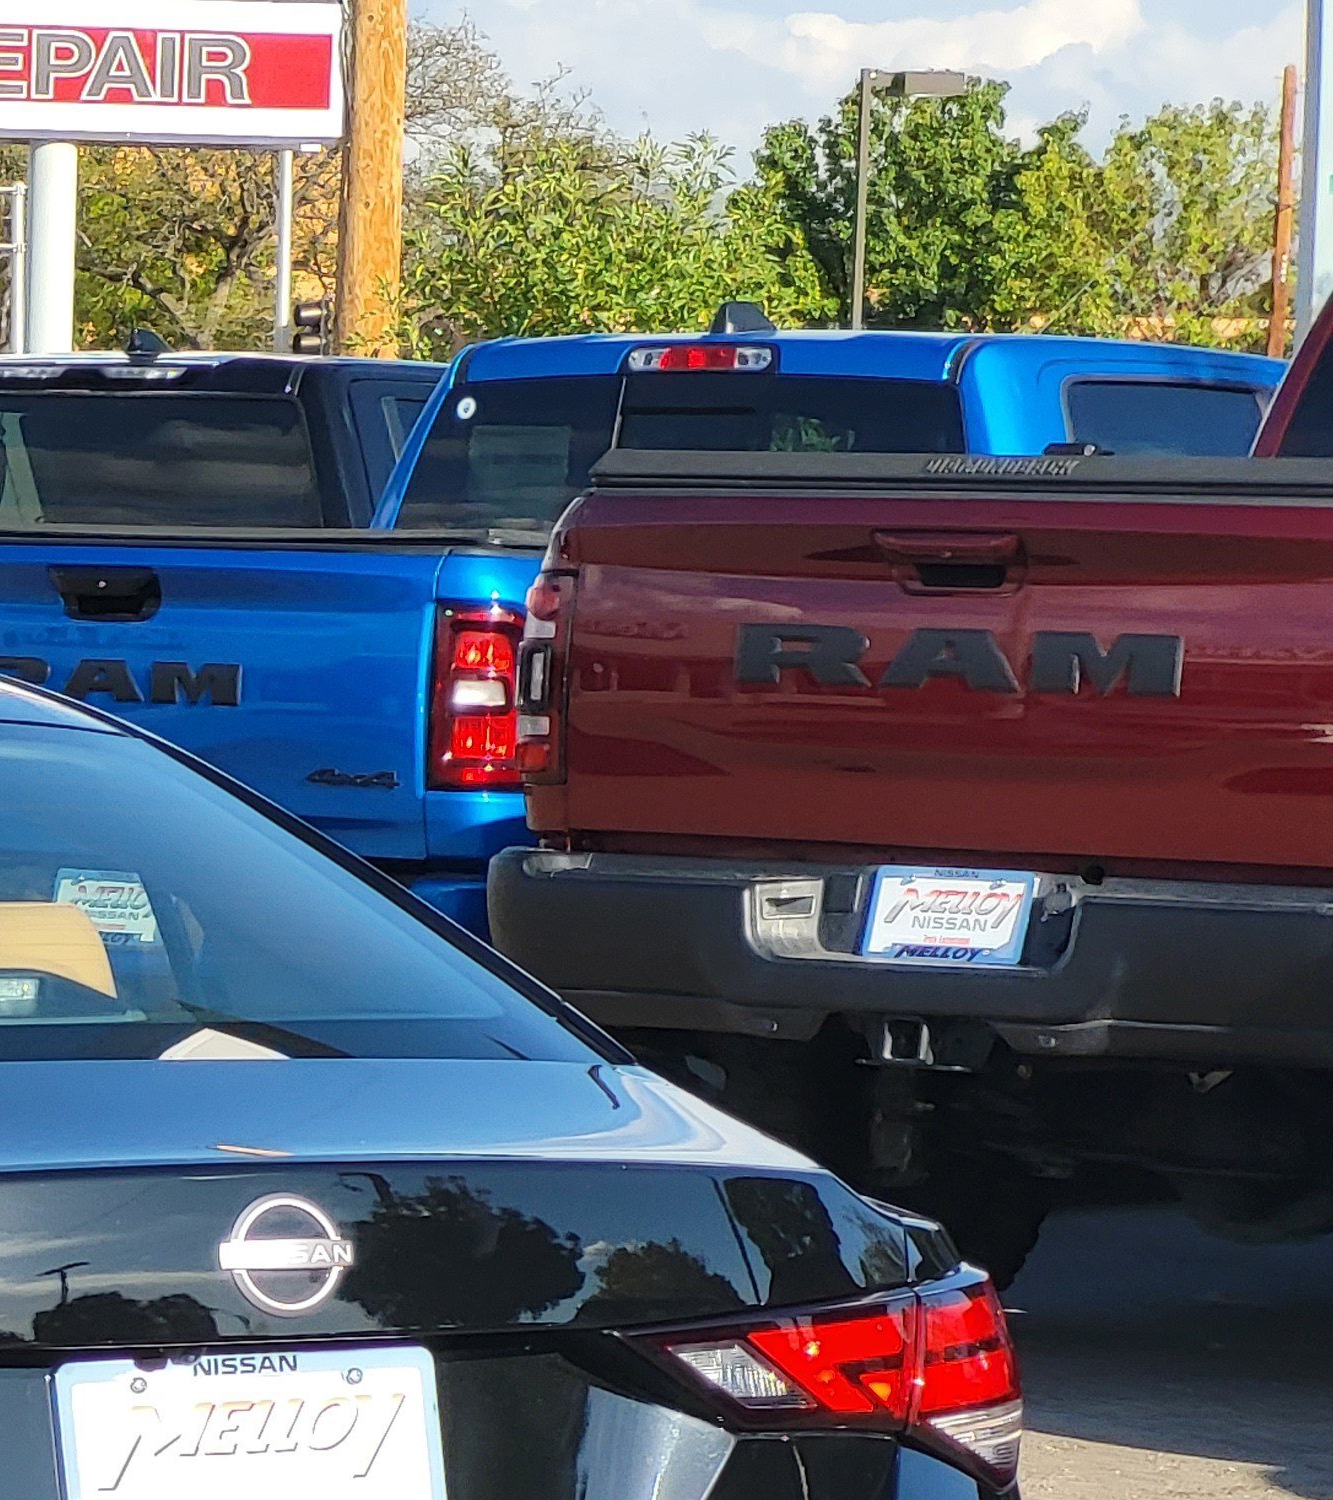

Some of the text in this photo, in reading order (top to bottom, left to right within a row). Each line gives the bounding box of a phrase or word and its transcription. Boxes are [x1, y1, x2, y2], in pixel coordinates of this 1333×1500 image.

[735, 622, 1186, 699] RAM
[884, 887, 1023, 930] MELLOY
[911, 914, 988, 932] NISSAN
[894, 944, 985, 962] MELLOY
[193, 1353, 299, 1377] NISSAN
[97, 1393, 406, 1492] MELLOY
